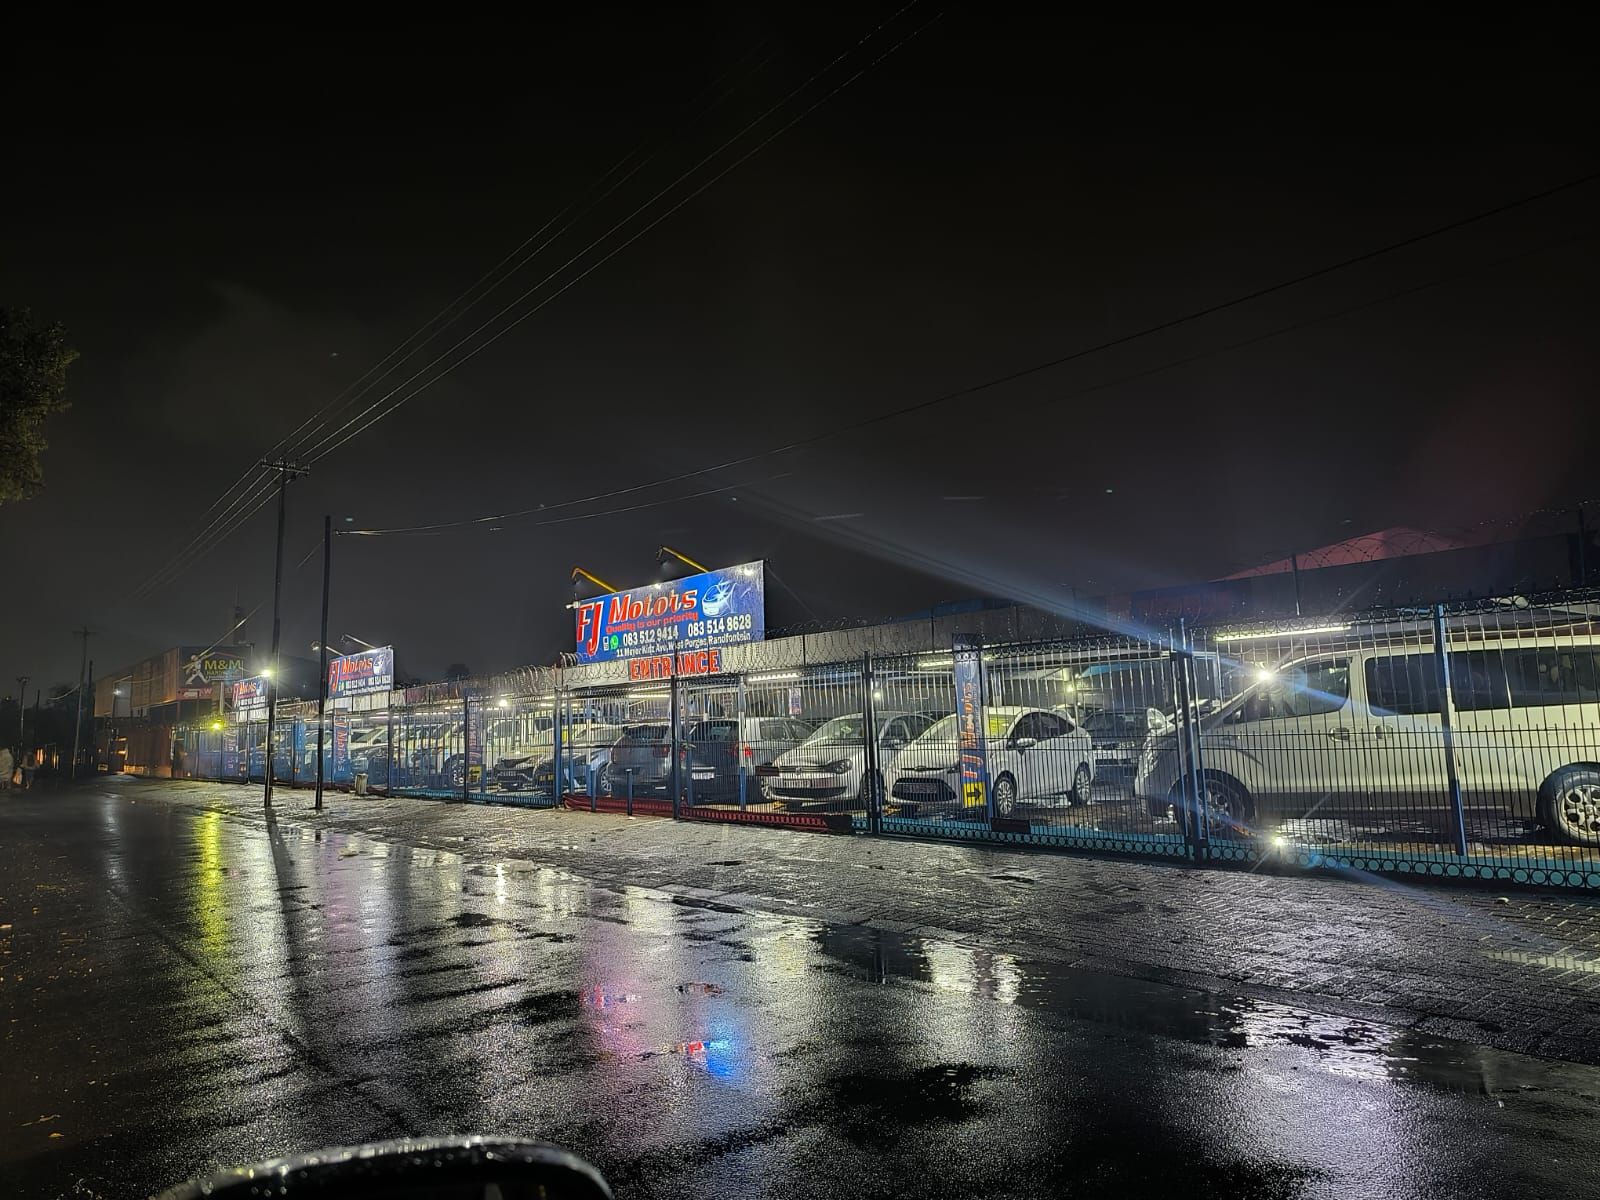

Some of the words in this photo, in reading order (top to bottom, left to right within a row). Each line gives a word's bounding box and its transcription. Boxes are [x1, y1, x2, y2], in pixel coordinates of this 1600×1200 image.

[577, 601, 603, 656] FJ
[608, 589, 698, 624] Motors
[606, 622, 636, 635] Quality
[637, 621, 645, 629] is
[646, 618, 662, 627] our
[663, 611, 698, 626] priority
[623, 632, 638, 646] 083
[640, 629, 655, 644] 512
[656, 625, 679, 641] 9414
[688, 621, 705, 637] 083
[706, 617, 725, 634] 514
[726, 613, 752, 631] 8628
[708, 631, 751, 645] Randfontein
